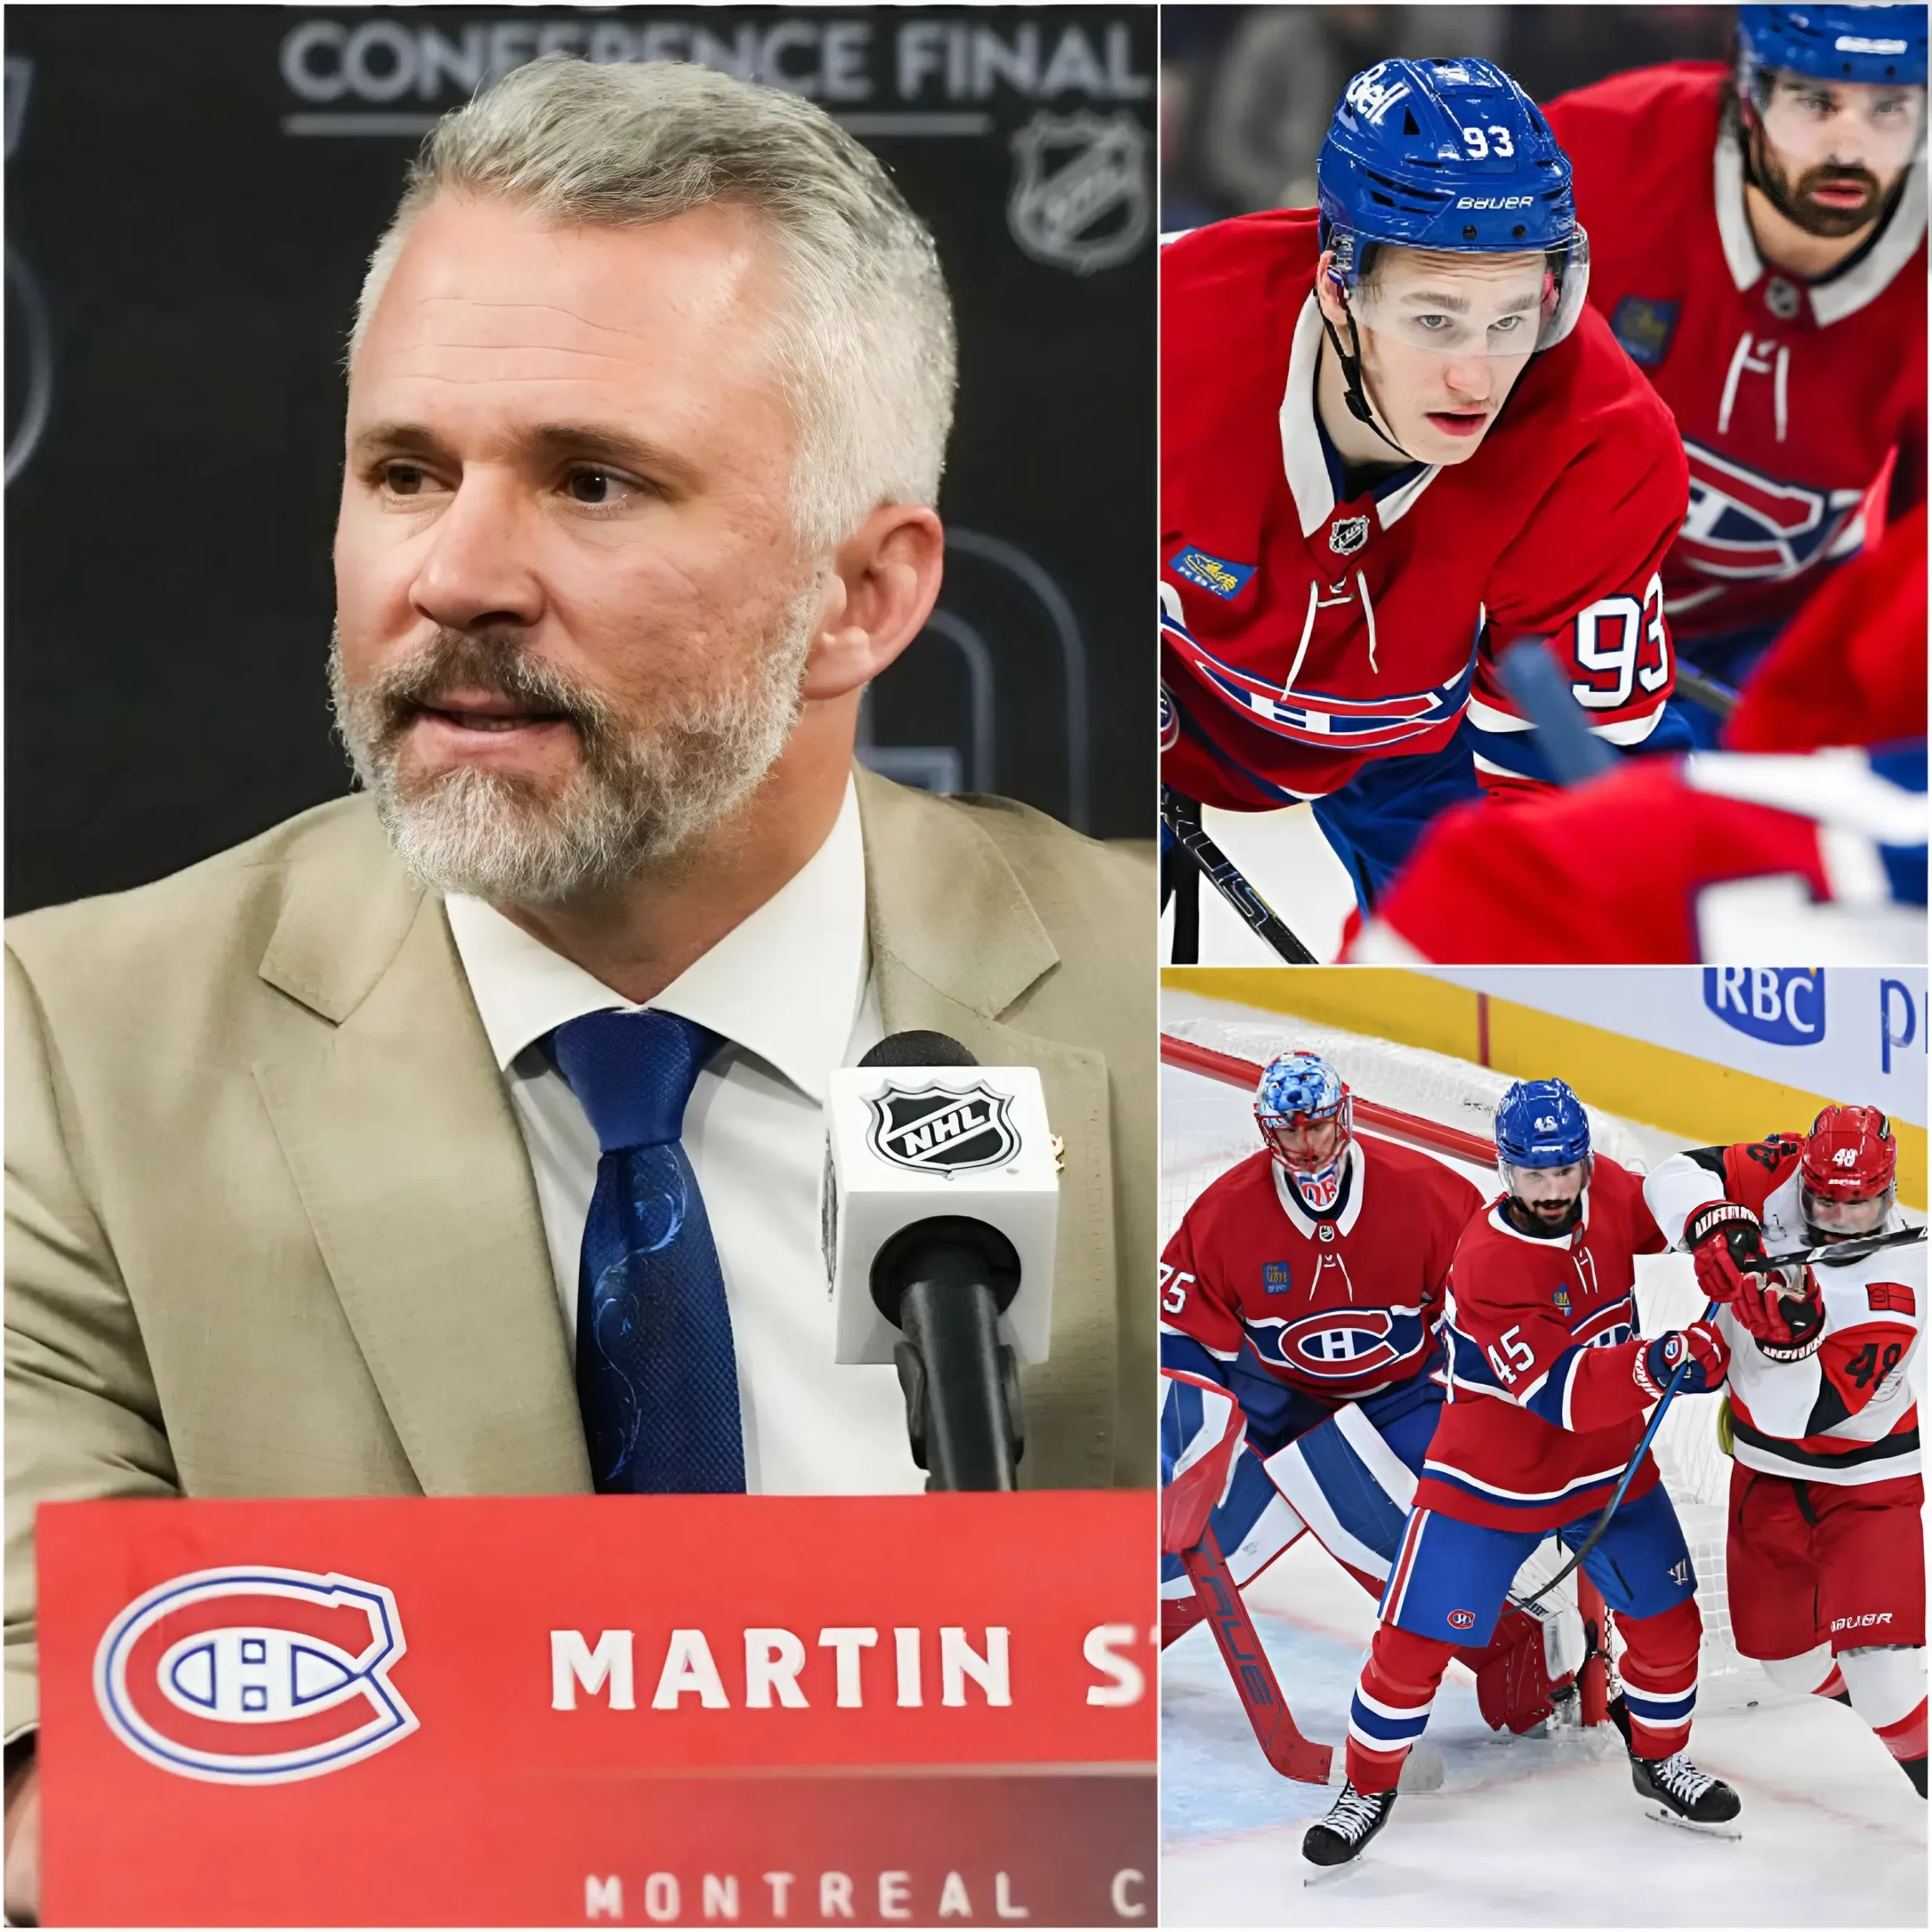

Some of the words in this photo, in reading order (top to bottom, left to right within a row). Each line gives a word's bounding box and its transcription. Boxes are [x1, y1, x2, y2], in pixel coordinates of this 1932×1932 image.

[895, 21, 1152, 102] FINAL
[1346, 63, 1411, 126] Bell
[1463, 125, 1515, 158] 93
[1456, 196, 1534, 210] BAUER
[1571, 570, 1669, 708] 93
[1716, 968, 1815, 1033] RBC
[1880, 978, 1928, 1075] p
[901, 1104, 986, 1158] NHL
[1487, 1324, 1535, 1386] 45
[550, 1626, 1012, 1711] MARTIN
[1083, 1623, 1158, 1708] S
[585, 1871, 1029, 1921] MONTREAL
